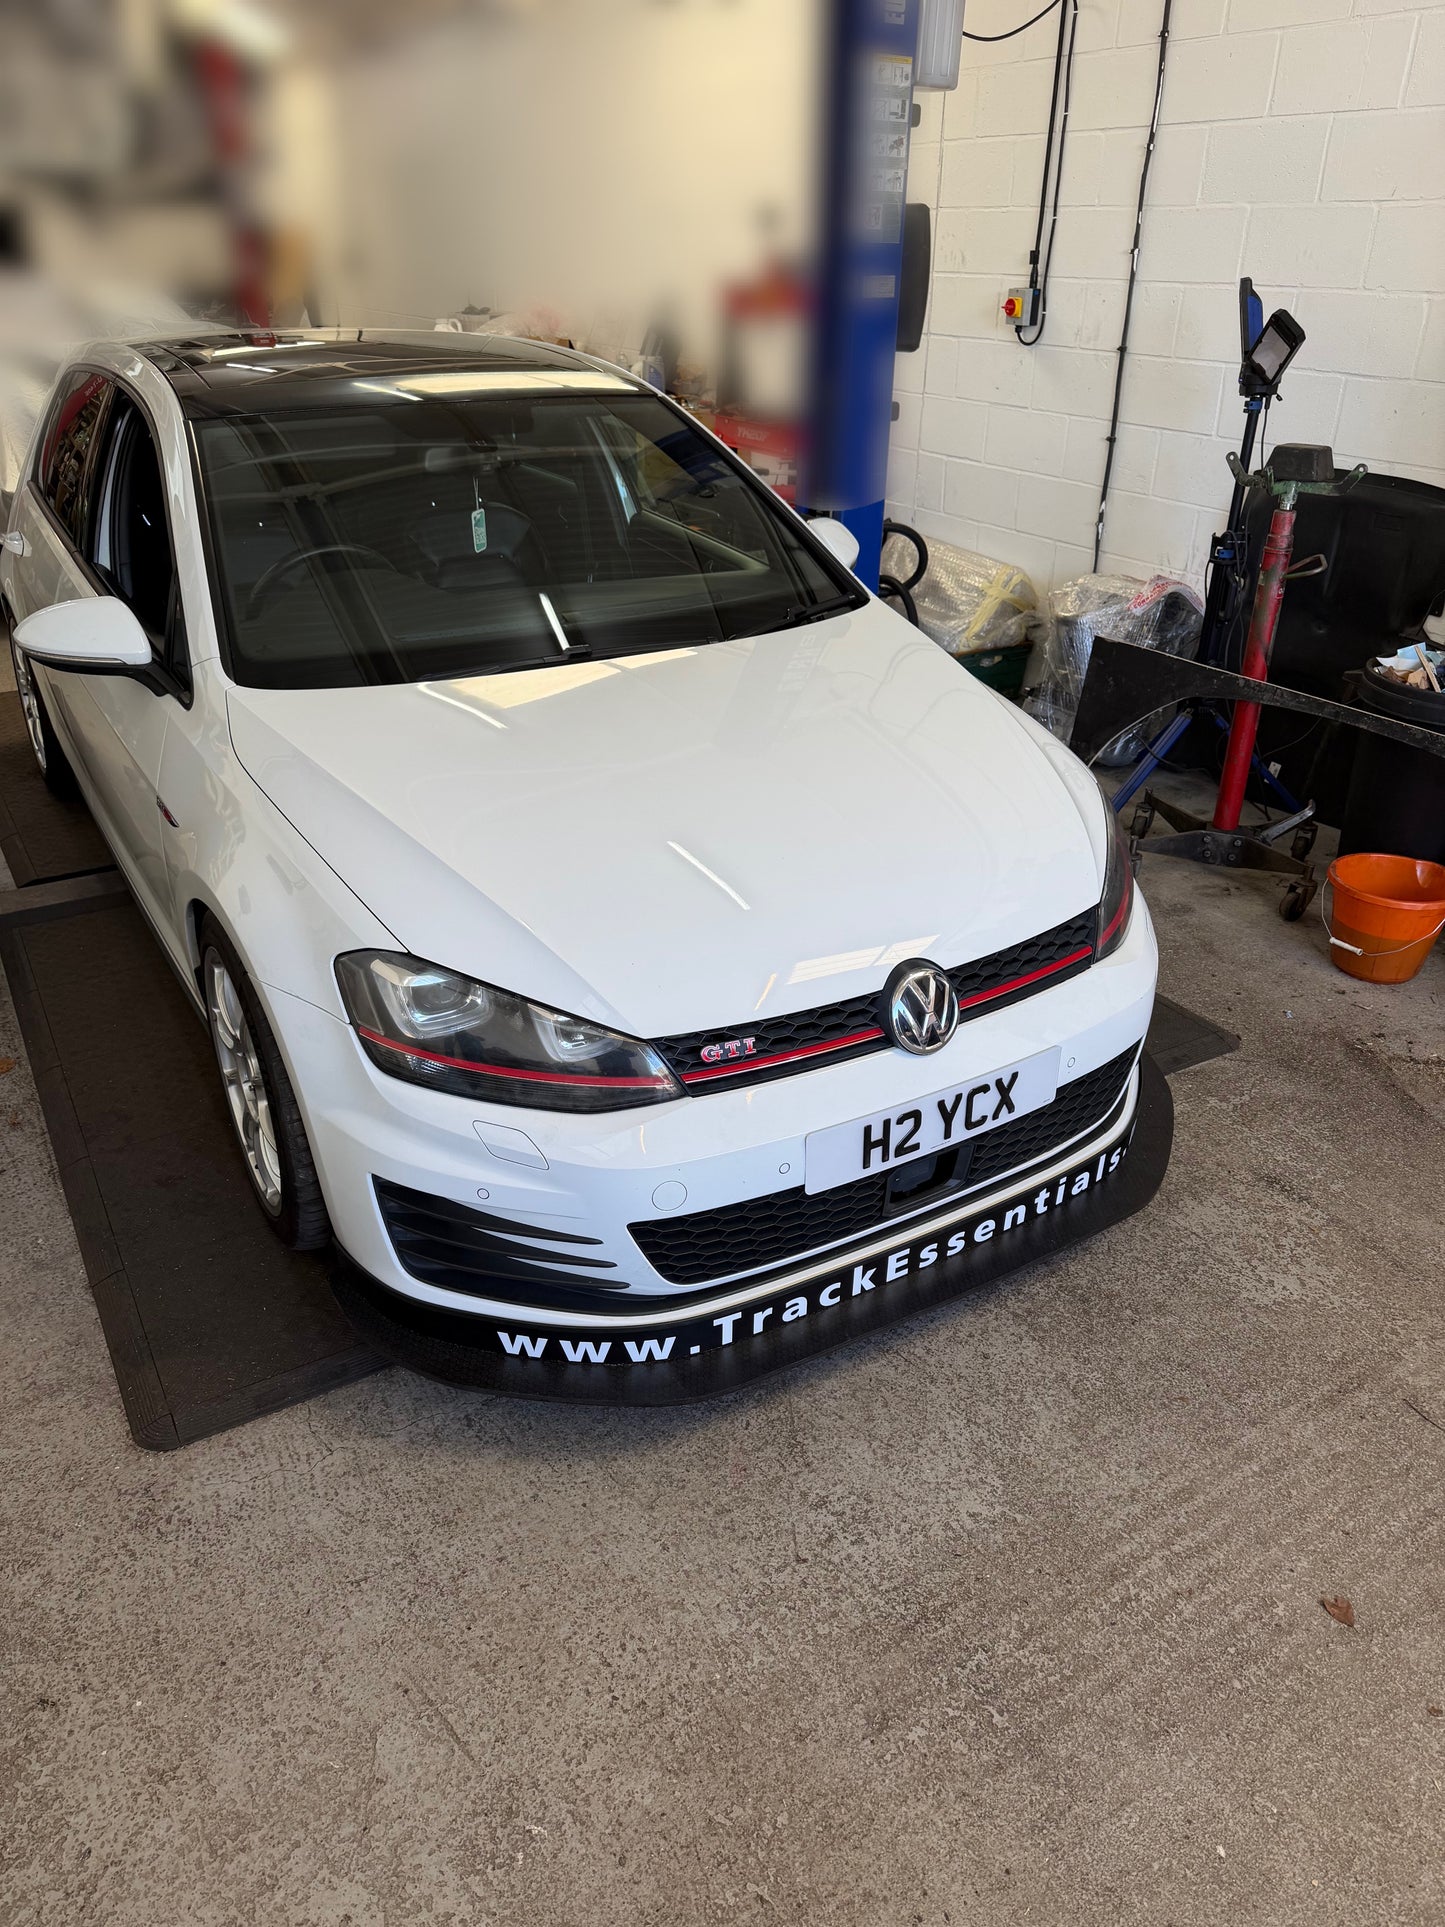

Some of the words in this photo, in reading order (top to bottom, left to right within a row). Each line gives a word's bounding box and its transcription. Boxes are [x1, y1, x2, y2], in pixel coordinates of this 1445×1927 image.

[700, 1037, 757, 1063] GTI
[891, 969, 959, 1052] VW
[862, 1109, 922, 1169] H2
[937, 1071, 1019, 1140] YCX
